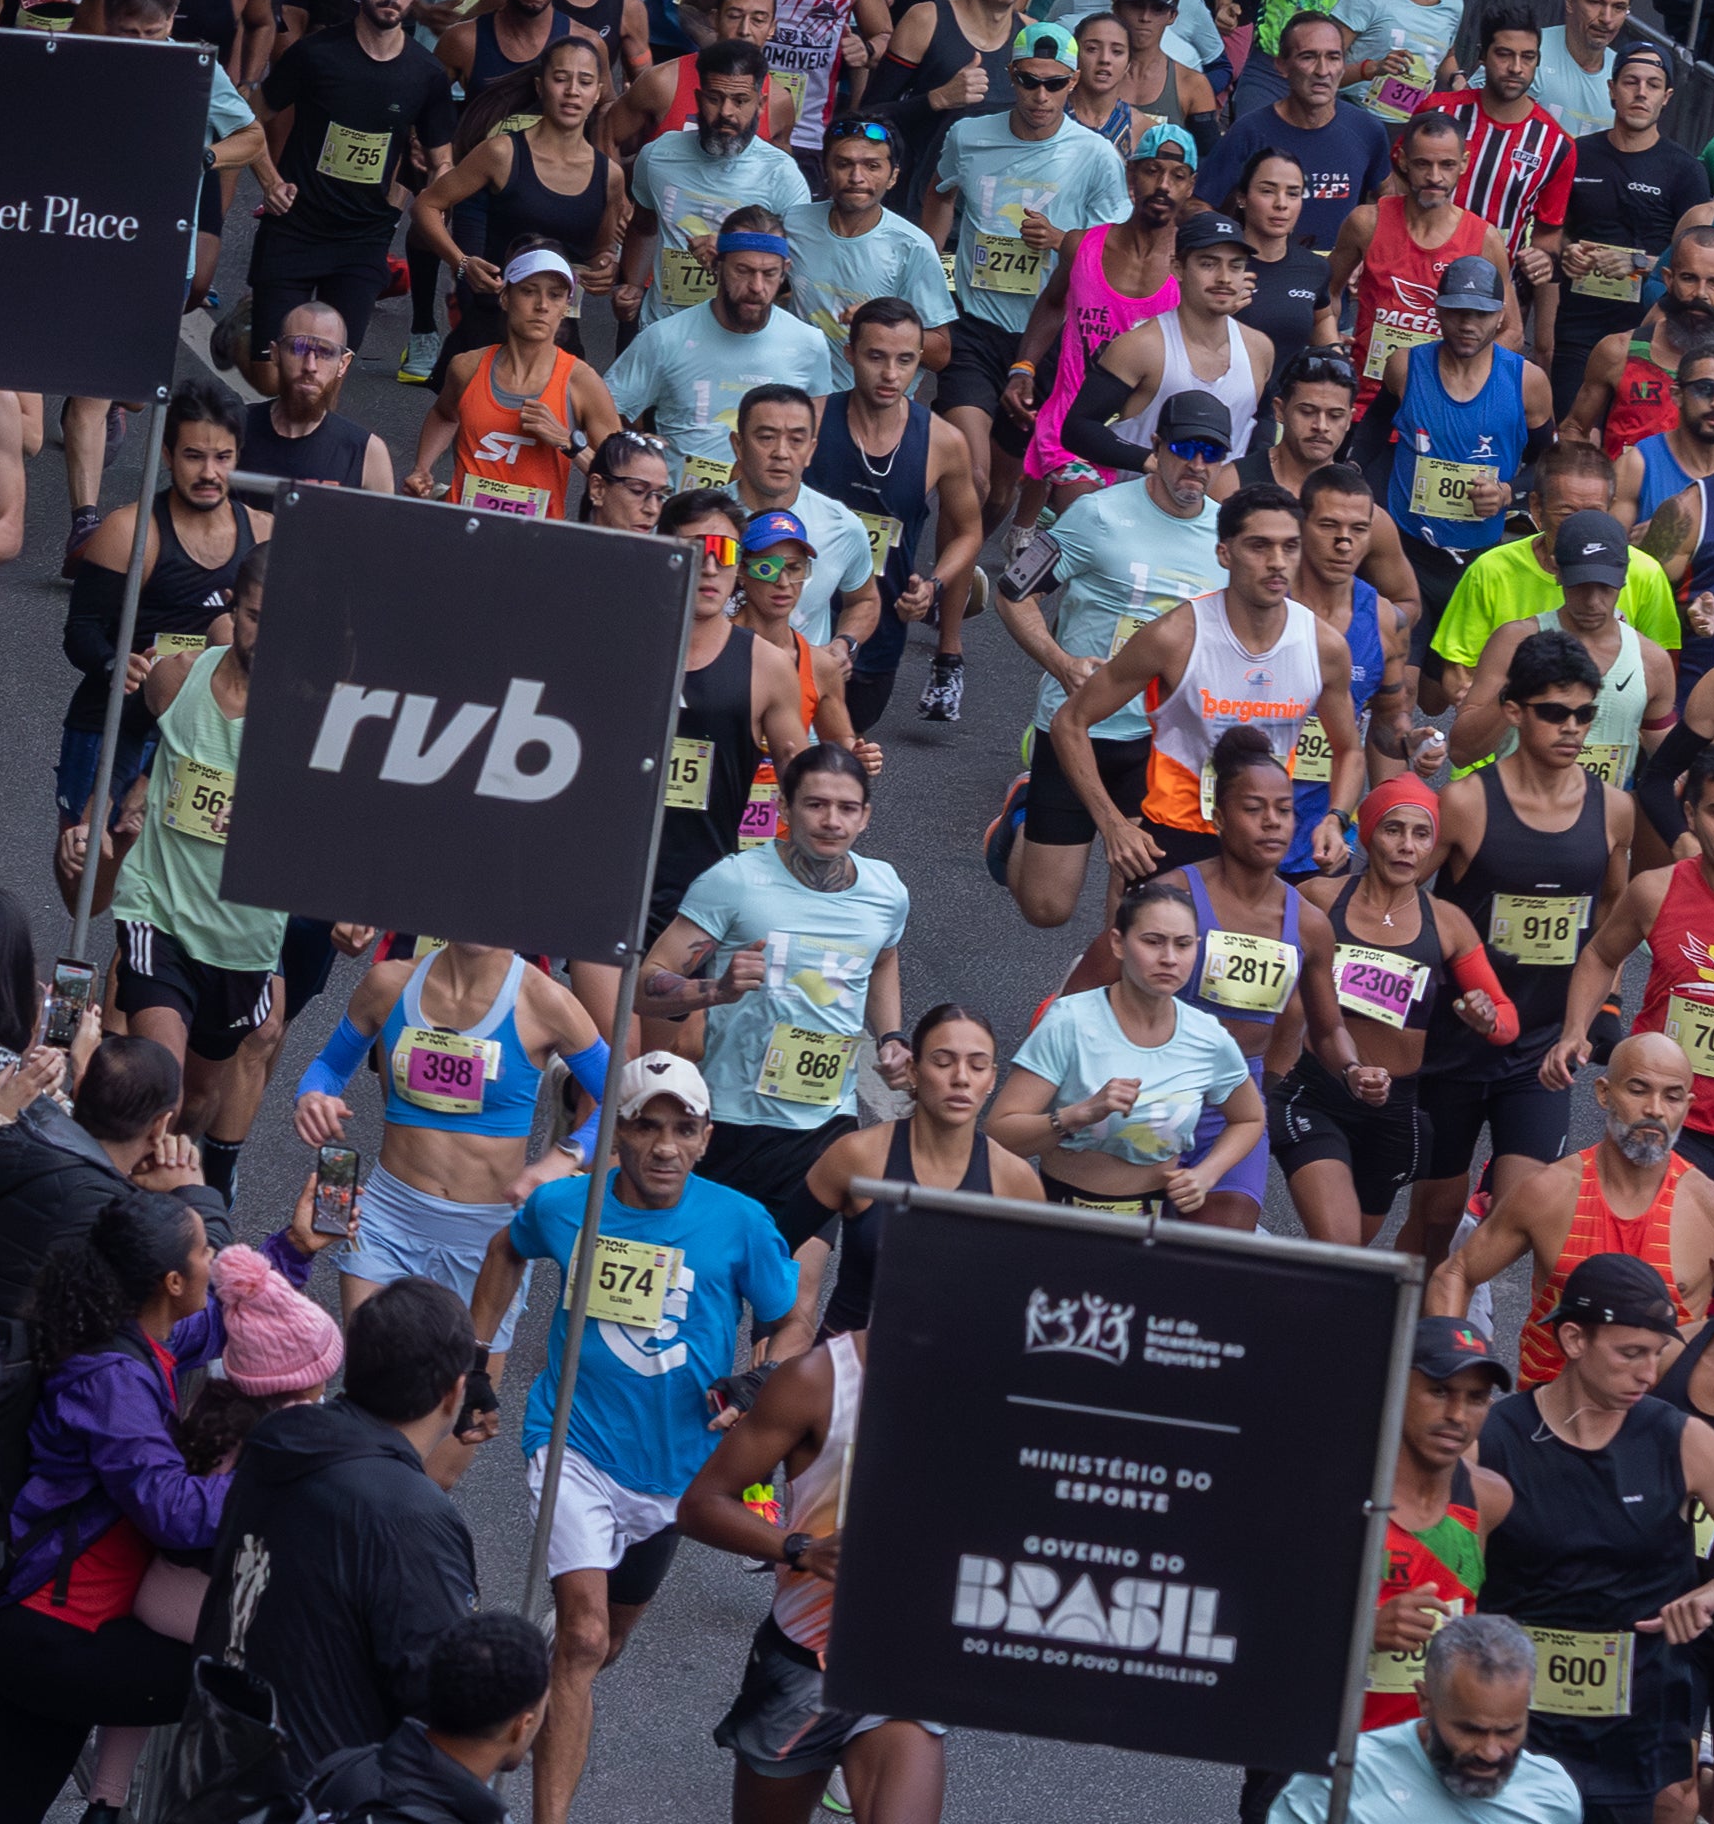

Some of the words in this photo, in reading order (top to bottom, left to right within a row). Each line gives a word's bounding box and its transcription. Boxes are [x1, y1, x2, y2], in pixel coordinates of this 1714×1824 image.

[346, 145, 382, 168] 755
[40, 195, 140, 241] Place
[989, 250, 1040, 277] 2747
[308, 678, 581, 803] rvb
[1523, 917, 1570, 942] 918
[1227, 955, 1285, 989] 2817
[1348, 963, 1409, 1004] 2306
[423, 1055, 473, 1086] 398
[796, 1050, 841, 1079] 868
[598, 1261, 652, 1297] 574
[1146, 1314, 1172, 1334] Lei
[1177, 1318, 1199, 1336] de
[1143, 1346, 1206, 1371] Esporte
[1220, 1342, 1245, 1359] ao
[1018, 1445, 1169, 1487] MINISTÉRIO
[1176, 1468, 1212, 1492] DO
[1054, 1479, 1170, 1513] ESPORTE
[1023, 1534, 1140, 1569] GOVERNO
[1151, 1552, 1186, 1574] DO
[952, 1553, 1236, 1664] BRASIL
[963, 1636, 989, 1654] DO
[992, 1642, 1038, 1663] LADO
[1043, 1648, 1068, 1665] DO
[1071, 1651, 1119, 1674] POVO
[1123, 1658, 1218, 1687] BRASILEIRO
[1548, 1653, 1606, 1687] 600
